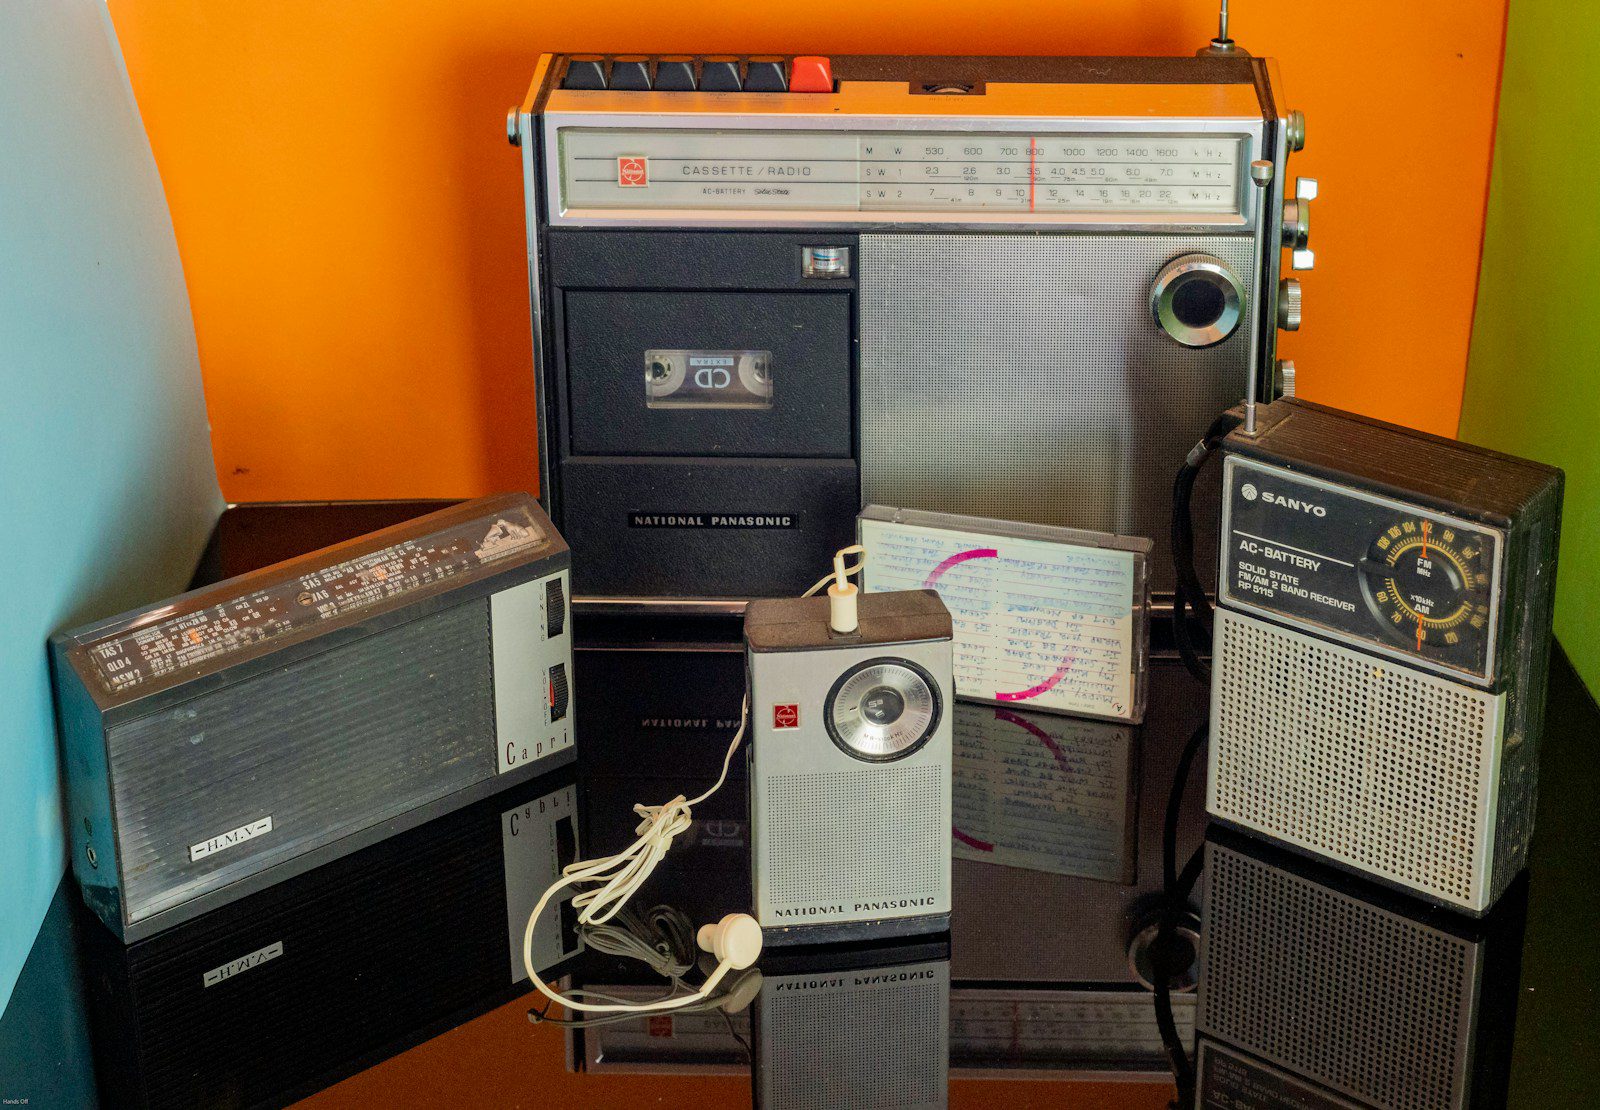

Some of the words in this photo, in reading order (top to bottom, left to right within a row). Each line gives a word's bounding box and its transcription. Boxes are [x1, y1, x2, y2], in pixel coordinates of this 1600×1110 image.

[1097, 148, 1118, 156] 1200
[694, 368, 730, 388] CD
[1262, 492, 1326, 518] SANYO
[634, 516, 704, 525] NATIONAL
[712, 516, 791, 526] PANASONIC
[1402, 522, 1416, 533] 104
[1240, 540, 1320, 572] AC-BATTERY
[1417, 558, 1432, 569] FM
[1238, 562, 1266, 576] SOLID
[1270, 570, 1299, 585] STATE
[1417, 568, 1431, 578] MHz
[1238, 580, 1251, 590] RP
[1253, 585, 1274, 598] 5115
[1239, 570, 1268, 586] FM/AM
[1272, 581, 1278, 590] 2
[1281, 584, 1308, 598] BAND
[1310, 592, 1355, 612] RECEIVER
[1414, 604, 1430, 615] AM
[1390, 612, 1402, 624] 70
[99, 646, 117, 658] TAS
[116, 644, 123, 653] 7
[106, 660, 125, 672] QLD
[125, 657, 132, 666] 4
[112, 671, 134, 684] NSW
[134, 669, 140, 677] 2
[506, 728, 566, 766] Capri
[775, 906, 845, 917] NATIONAL
[854, 897, 934, 912] PANASONIC
